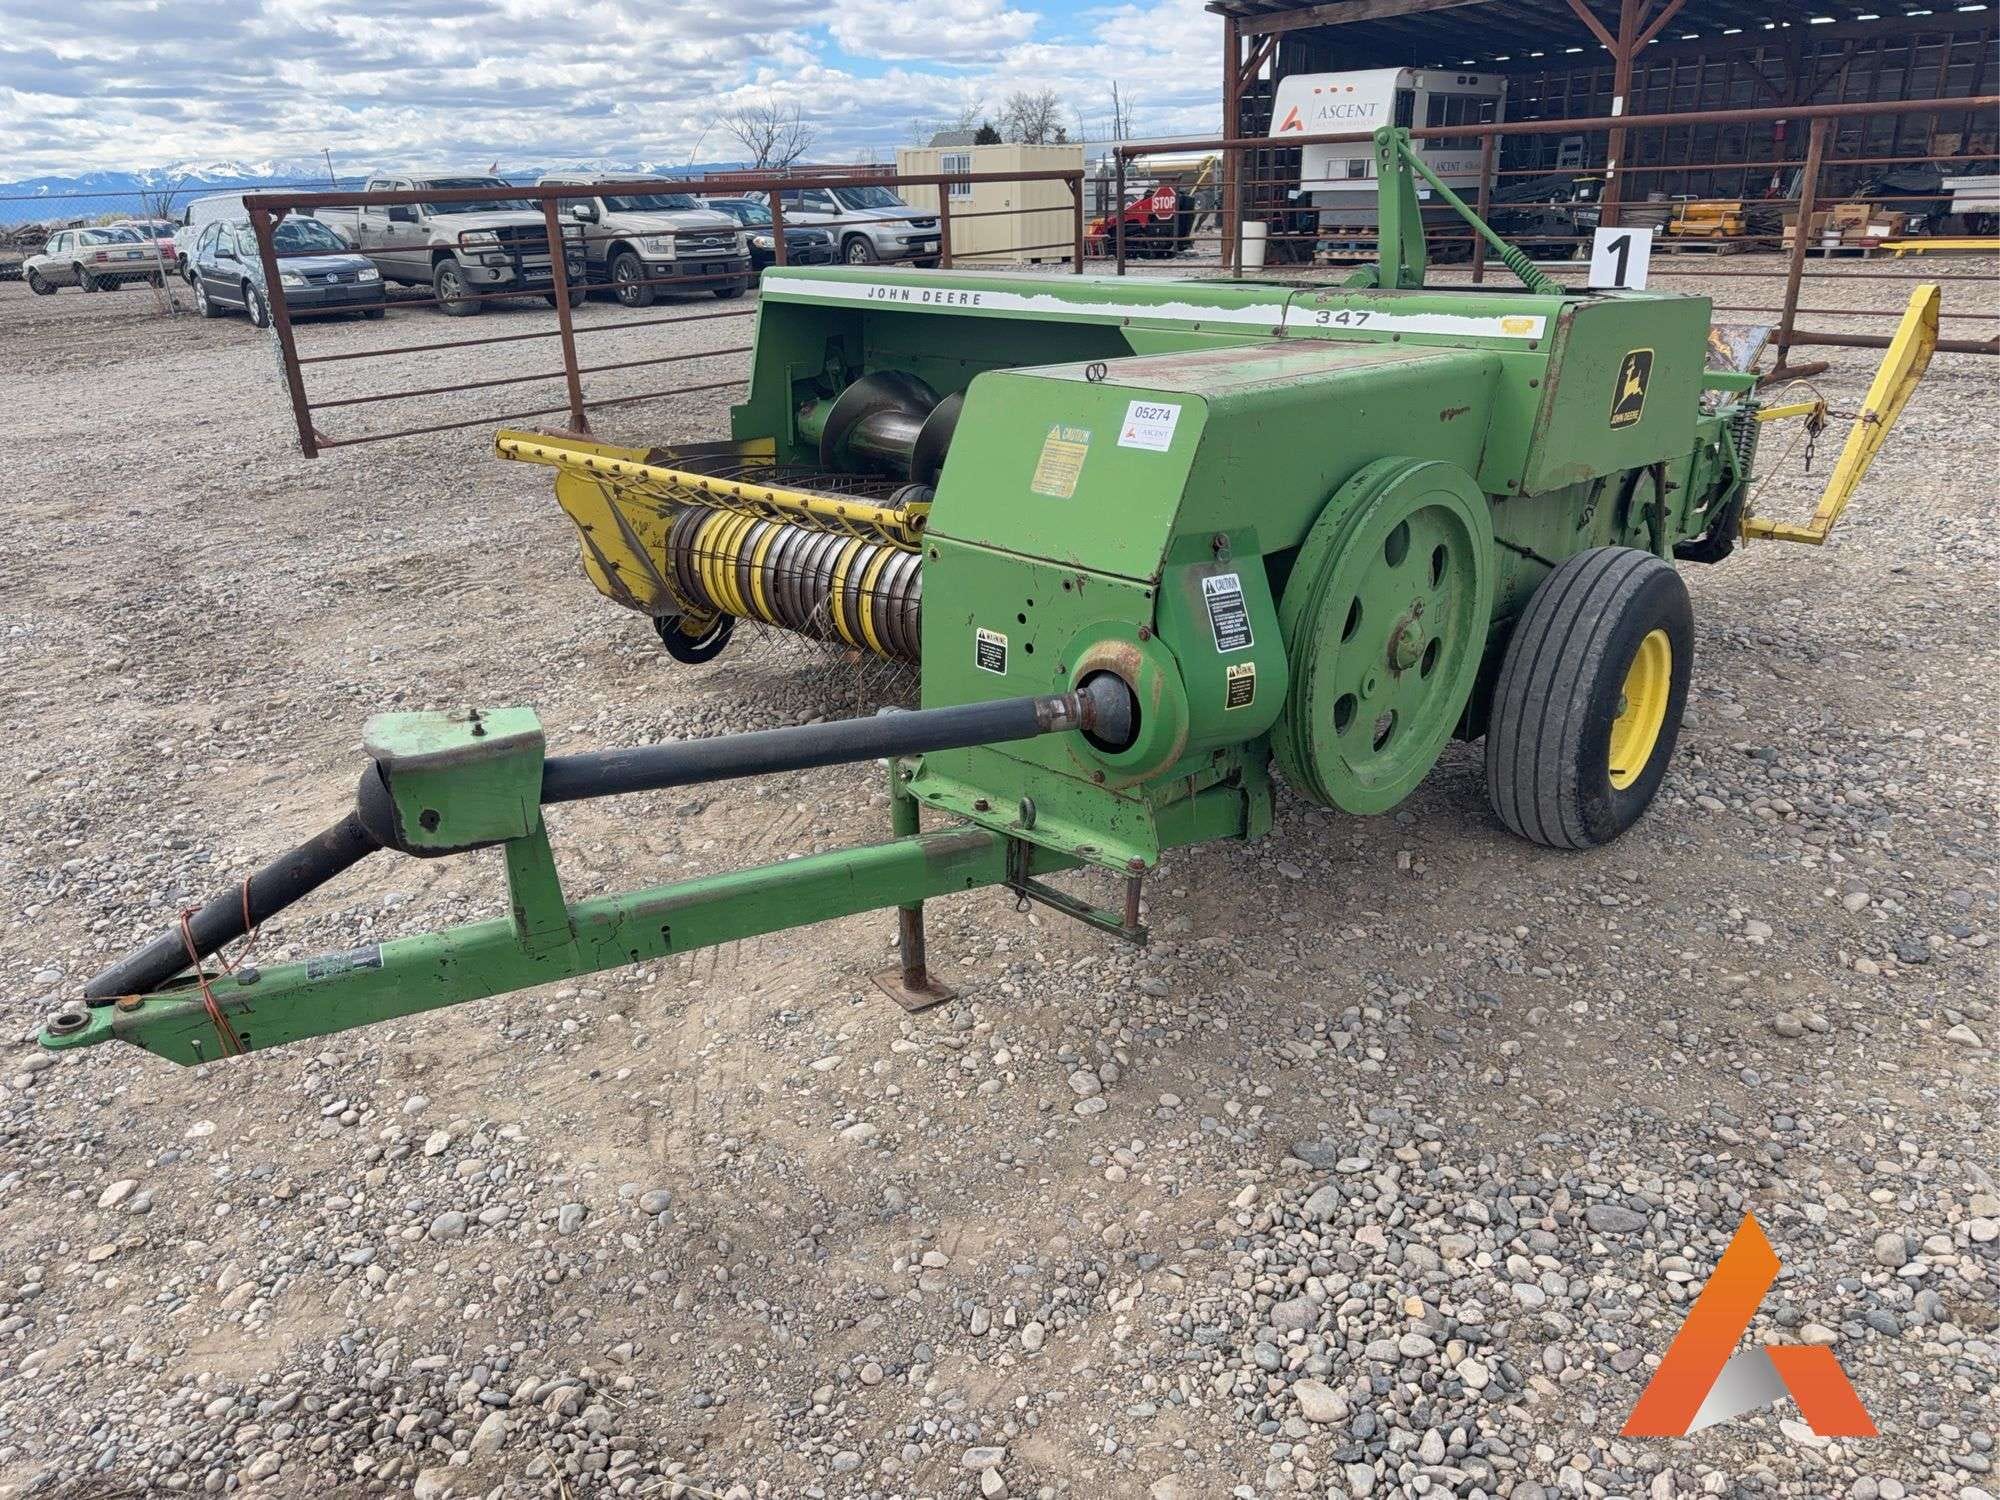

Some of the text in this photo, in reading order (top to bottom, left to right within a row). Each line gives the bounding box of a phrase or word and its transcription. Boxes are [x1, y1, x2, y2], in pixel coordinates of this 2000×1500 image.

[1318, 103, 1378, 119] ASCENT
[1154, 196, 1176, 209] STOP
[1607, 235, 1631, 286] 1
[868, 287, 981, 305] JOHN DEERE
[1315, 310, 1370, 327] 347
[1135, 406, 1171, 421] 05274
